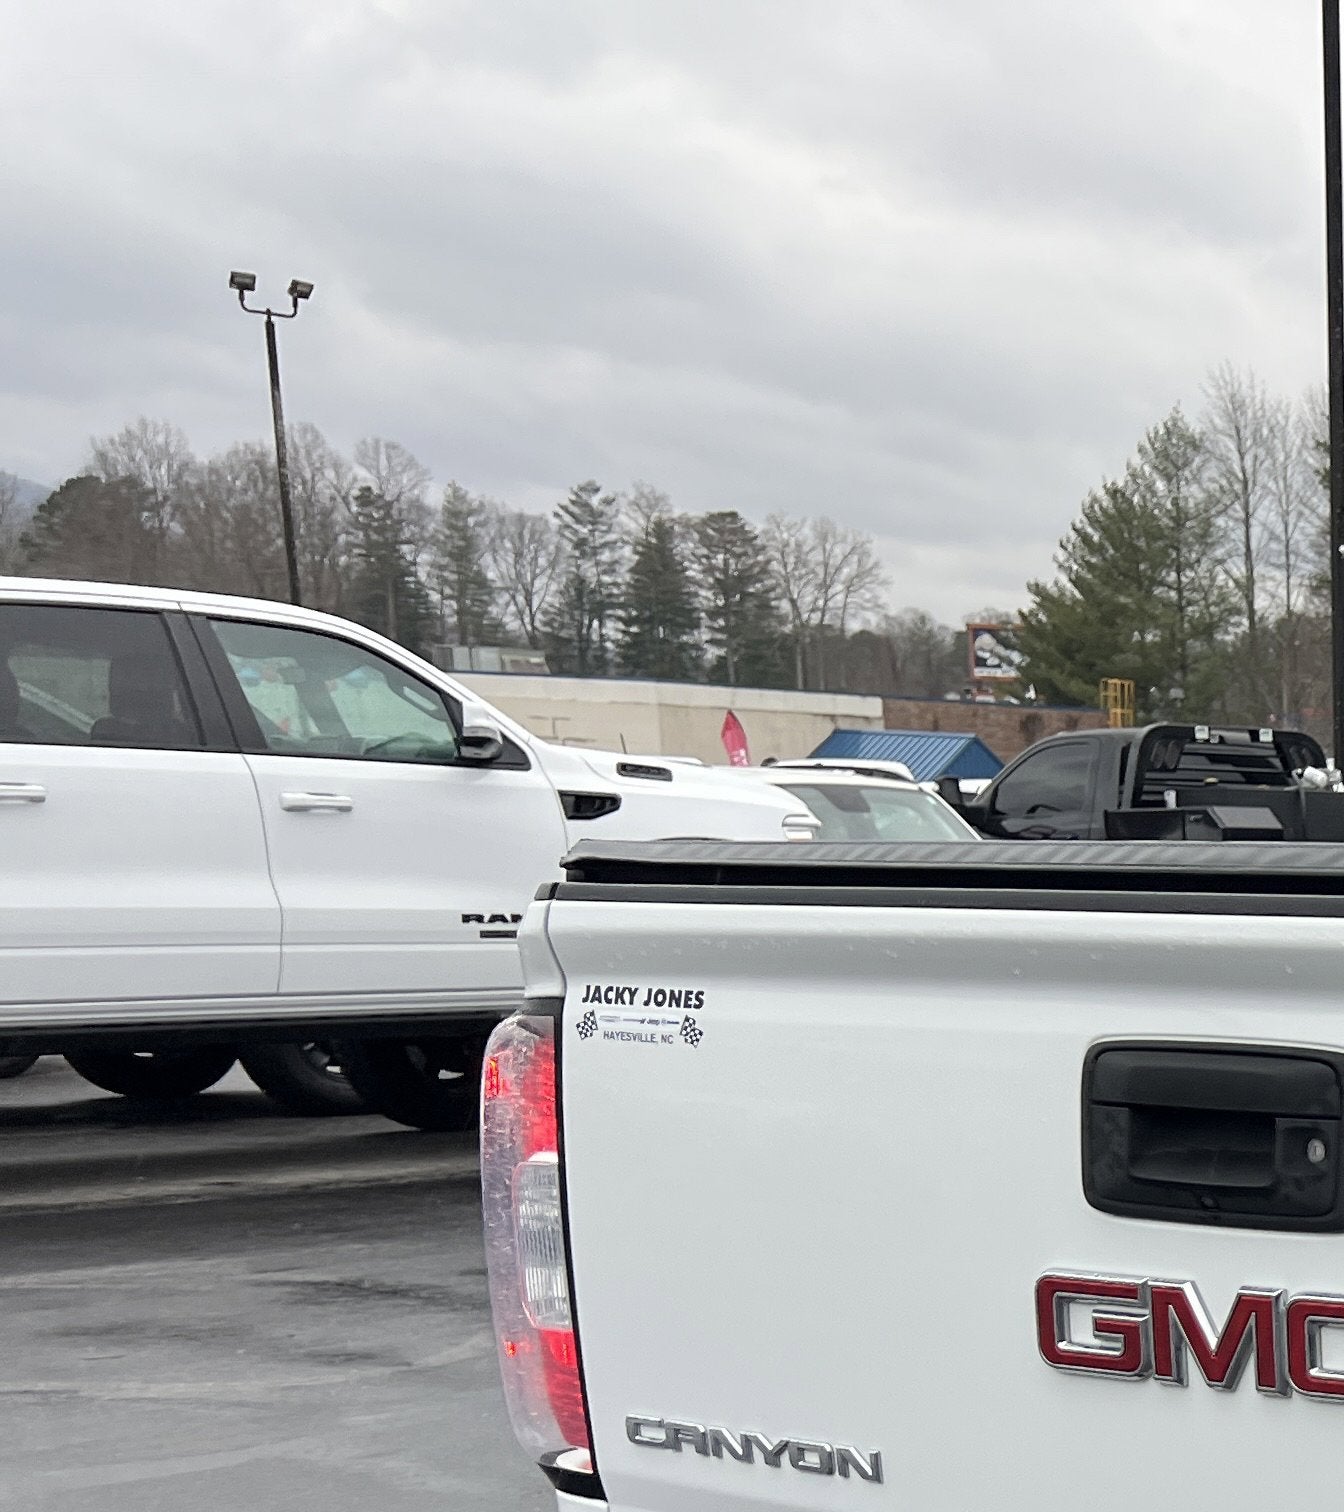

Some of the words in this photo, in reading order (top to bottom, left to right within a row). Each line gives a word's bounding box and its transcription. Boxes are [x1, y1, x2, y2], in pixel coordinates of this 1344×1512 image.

[581, 985, 639, 1006] JACKY
[642, 987, 705, 1010] JONES
[603, 1030, 659, 1045] HAYESVILLE,
[660, 1034, 674, 1045] NC
[625, 1413, 884, 1484] CANYON
